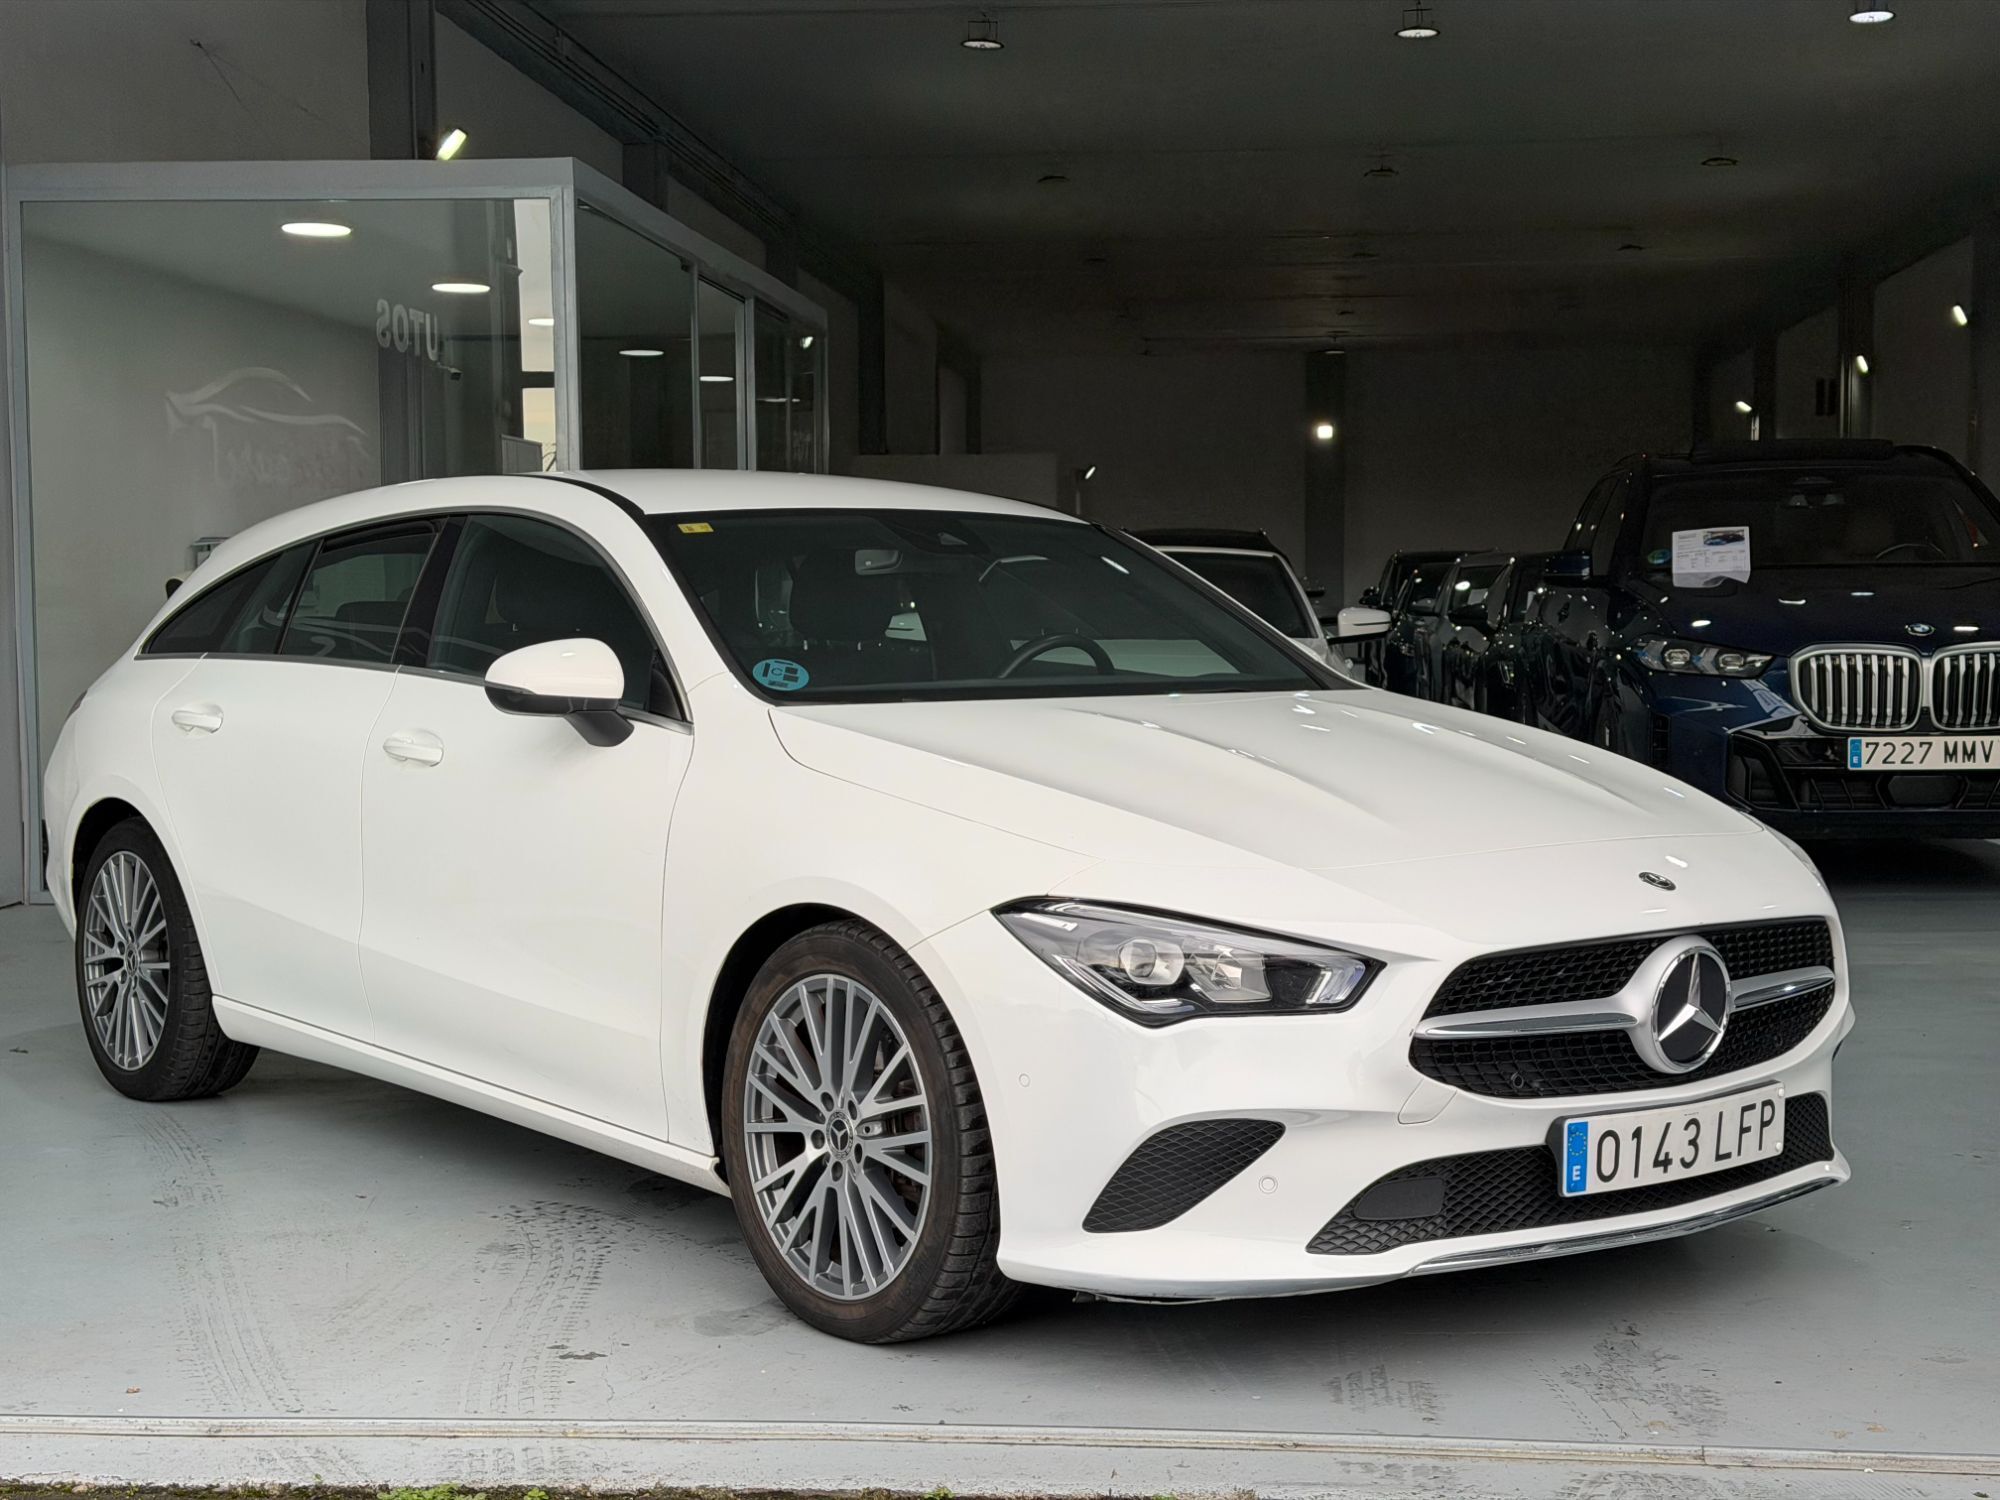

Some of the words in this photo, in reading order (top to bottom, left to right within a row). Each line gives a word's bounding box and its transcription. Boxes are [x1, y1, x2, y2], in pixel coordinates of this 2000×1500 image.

[1852, 756, 1859, 764] E
[1865, 742, 1933, 765] 7227
[1944, 740, 1994, 763] MMV
[1572, 1165, 1582, 1181] E
[1596, 1118, 1701, 1183] 0143
[1715, 1099, 1775, 1162] LFP
